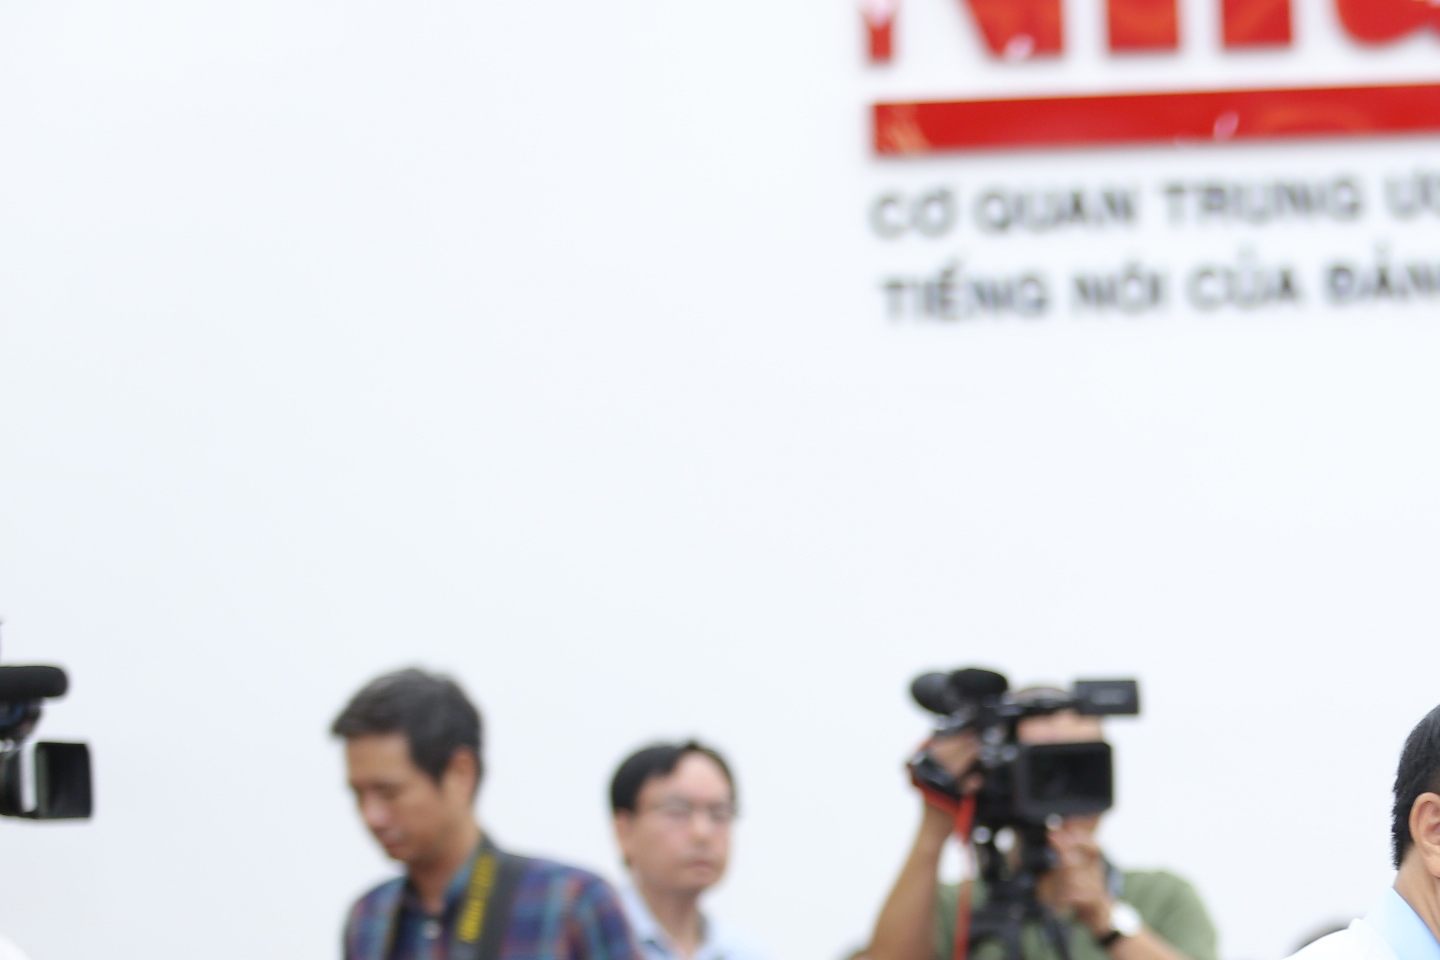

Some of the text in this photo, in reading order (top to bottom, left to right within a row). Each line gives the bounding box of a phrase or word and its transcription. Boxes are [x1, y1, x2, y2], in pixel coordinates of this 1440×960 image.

[868, 186, 958, 240] CƠ
[971, 186, 1140, 236] QUAN
[1160, 174, 1367, 226] TRUNG
[1070, 260, 1170, 316] NÓI
